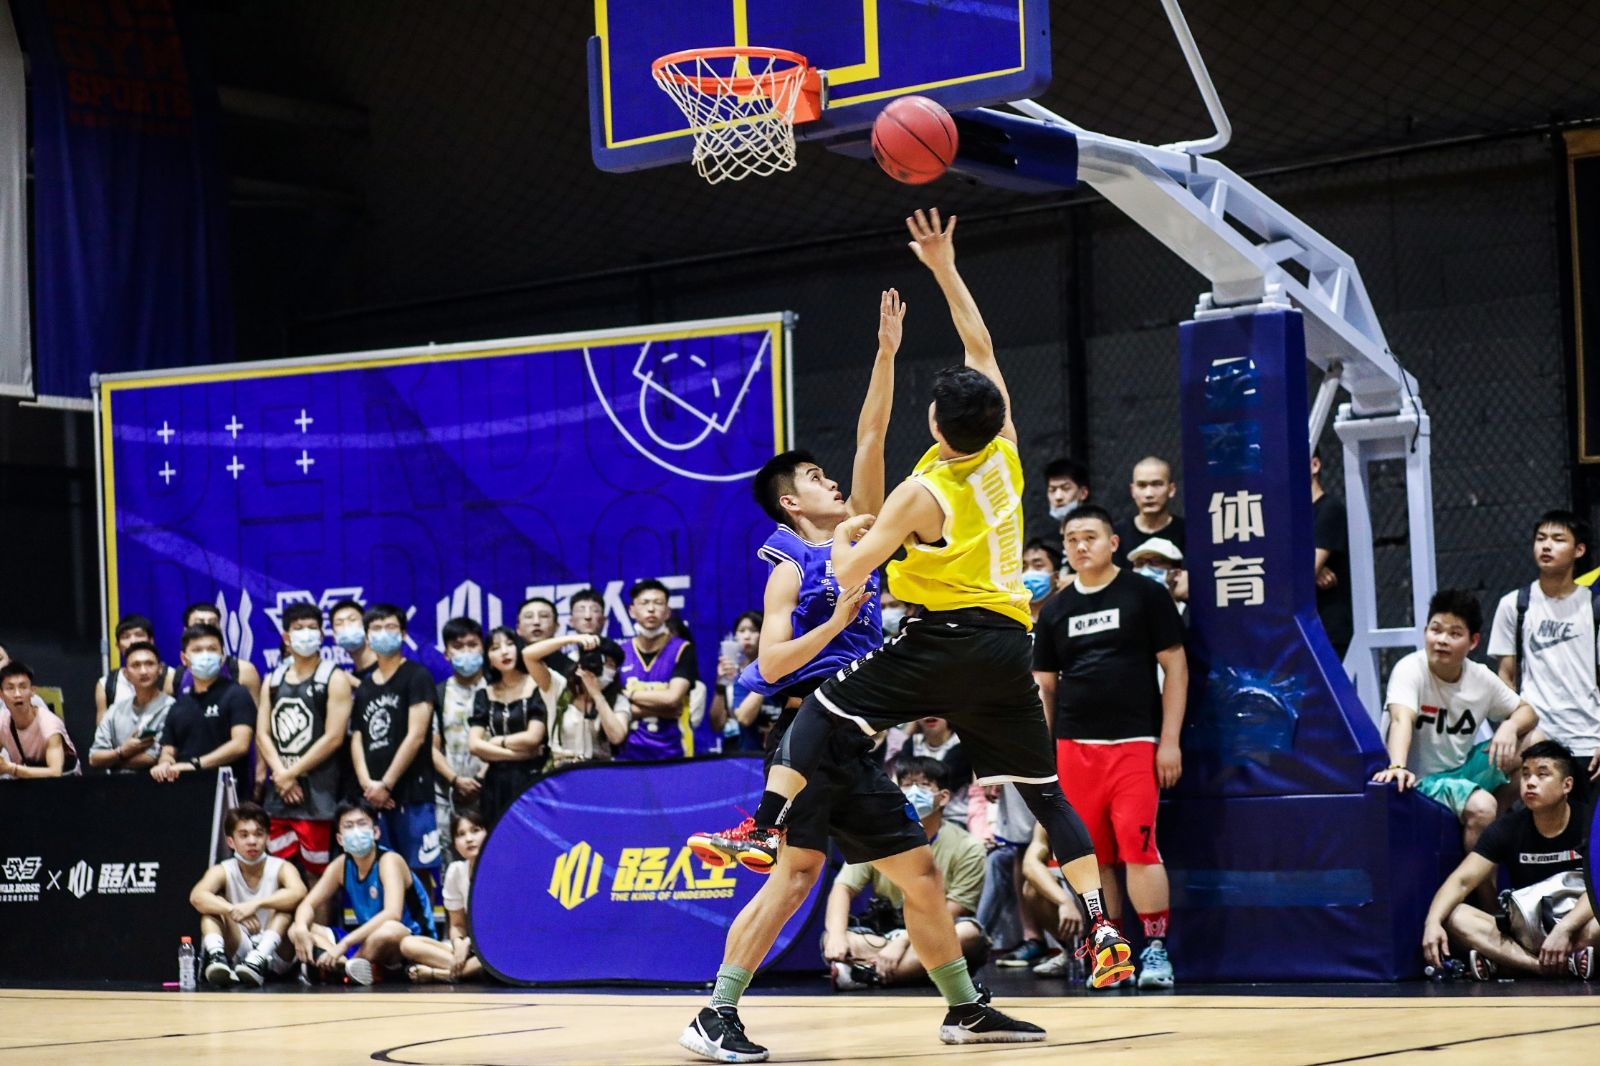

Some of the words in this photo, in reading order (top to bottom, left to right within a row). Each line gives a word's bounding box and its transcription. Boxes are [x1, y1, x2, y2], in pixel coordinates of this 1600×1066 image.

[981, 465, 1019, 576] UNDEDOGS
[1208, 490, 1266, 608] 体育
[1537, 619, 1573, 637] NIKE
[1415, 704, 1477, 735] FILA
[1140, 825, 1151, 853] 7
[98, 861, 160, 888] 路人王
[610, 892, 630, 902] THE
[631, 891, 656, 902] KING
[657, 890, 672, 901] OF
[673, 888, 735, 900] UNDERDOGS
